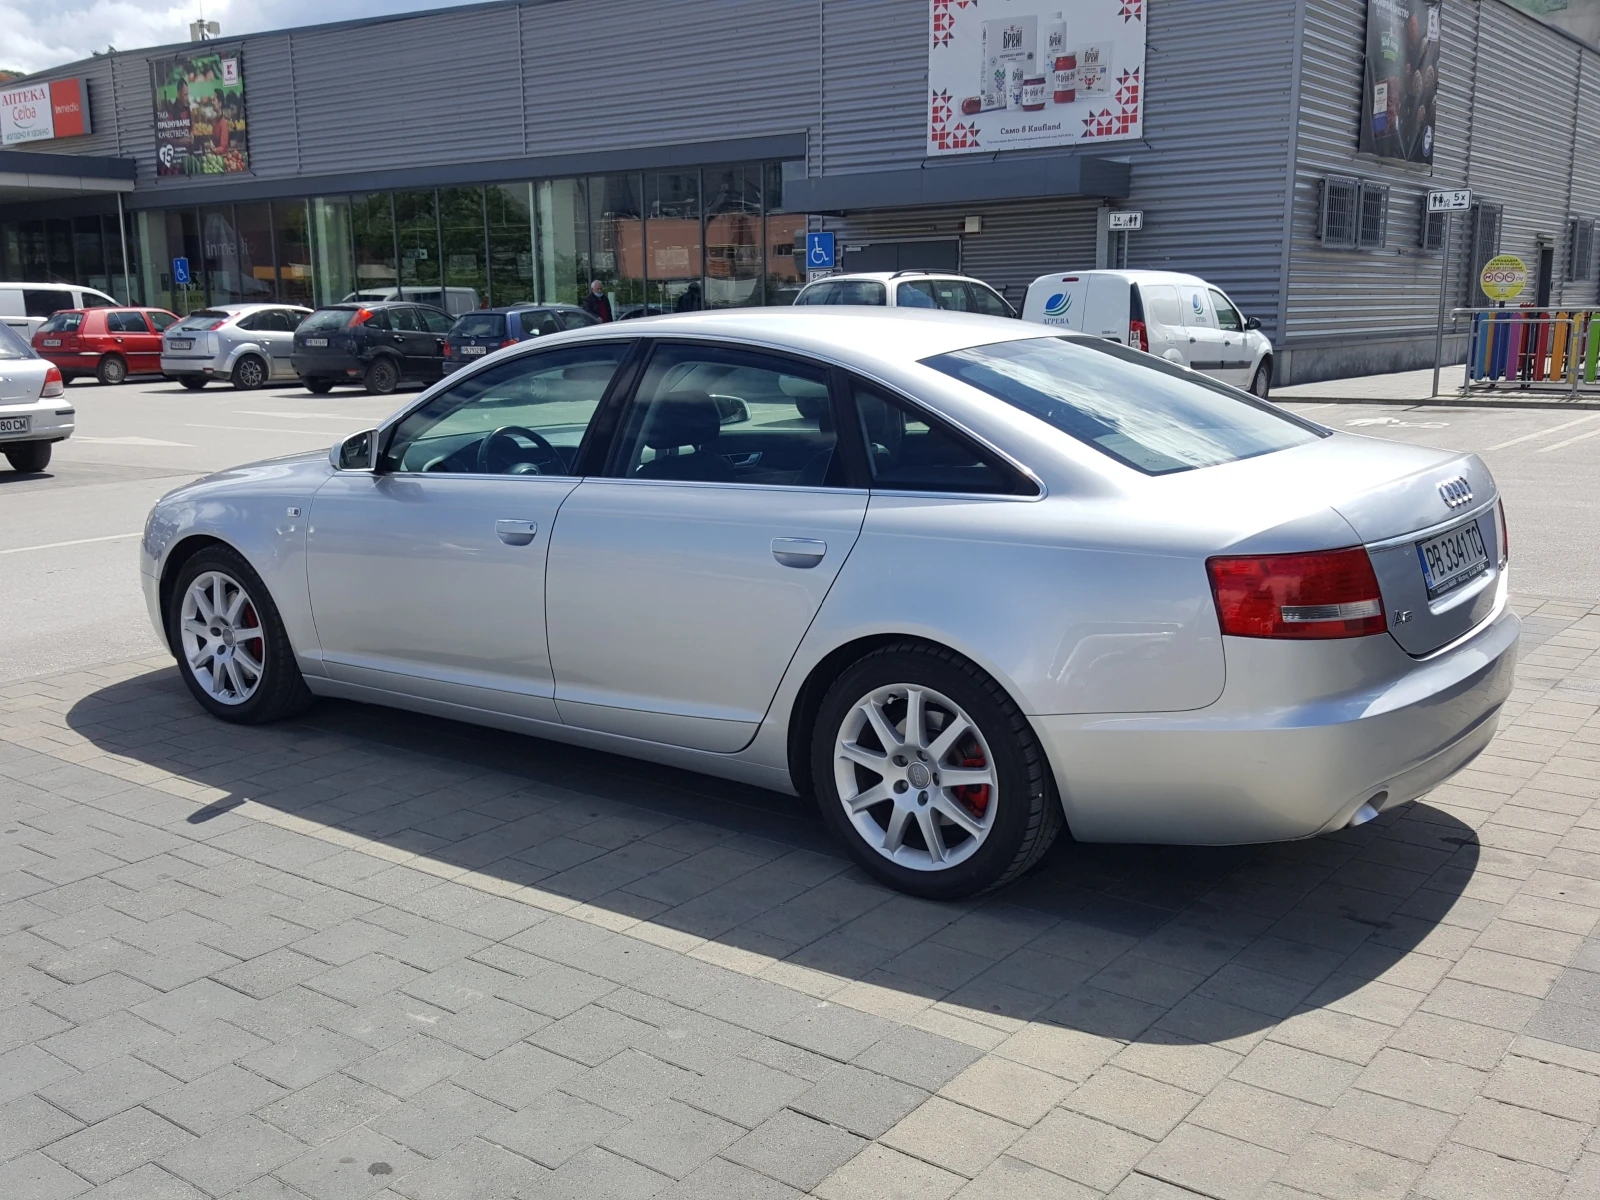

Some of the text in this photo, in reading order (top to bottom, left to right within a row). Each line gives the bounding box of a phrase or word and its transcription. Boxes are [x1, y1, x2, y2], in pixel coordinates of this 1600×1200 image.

[1003, 29, 1023, 49] Брей!
[2, 88, 46, 107] АПТЕКА
[12, 105, 36, 121] Ceiba
[55, 102, 79, 114] inmedio
[157, 111, 169, 119] ТАКА
[157, 119, 190, 129] ПРАЗНУВАМЕ
[1000, 127, 1020, 135] Само
[1027, 122, 1061, 132] Kaufland
[161, 148, 173, 164] 15
[1043, 317, 1070, 325] АГРЕВА
[1392, 609, 1412, 628] A6
